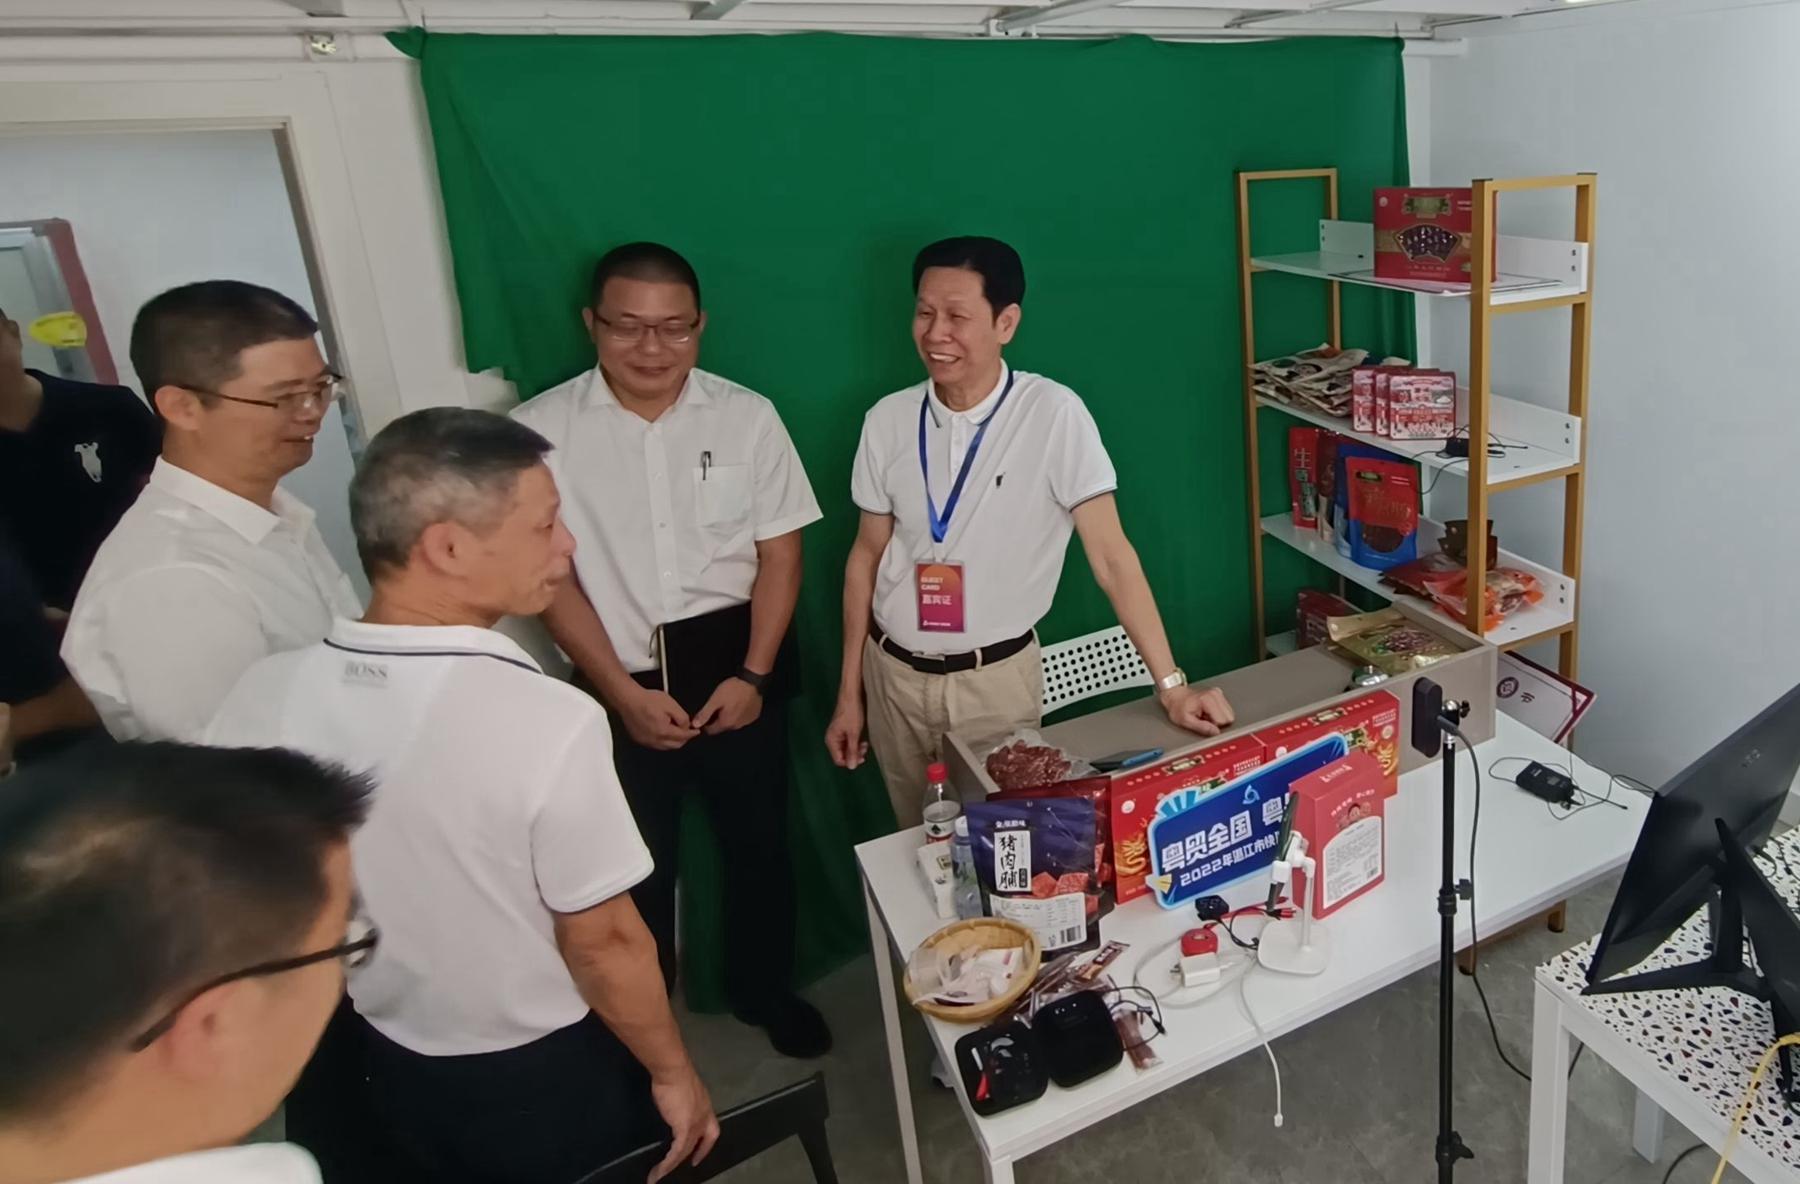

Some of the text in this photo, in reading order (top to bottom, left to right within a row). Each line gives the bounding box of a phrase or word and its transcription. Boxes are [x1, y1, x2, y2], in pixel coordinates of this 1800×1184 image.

[345, 661, 388, 678] BOSS
[1162, 810, 1253, 873] 粤贸全国
[1262, 793, 1290, 827] 粤
[1180, 831, 1280, 887] 2022年湛江市快
[999, 834, 1018, 889] 猪肉脯
